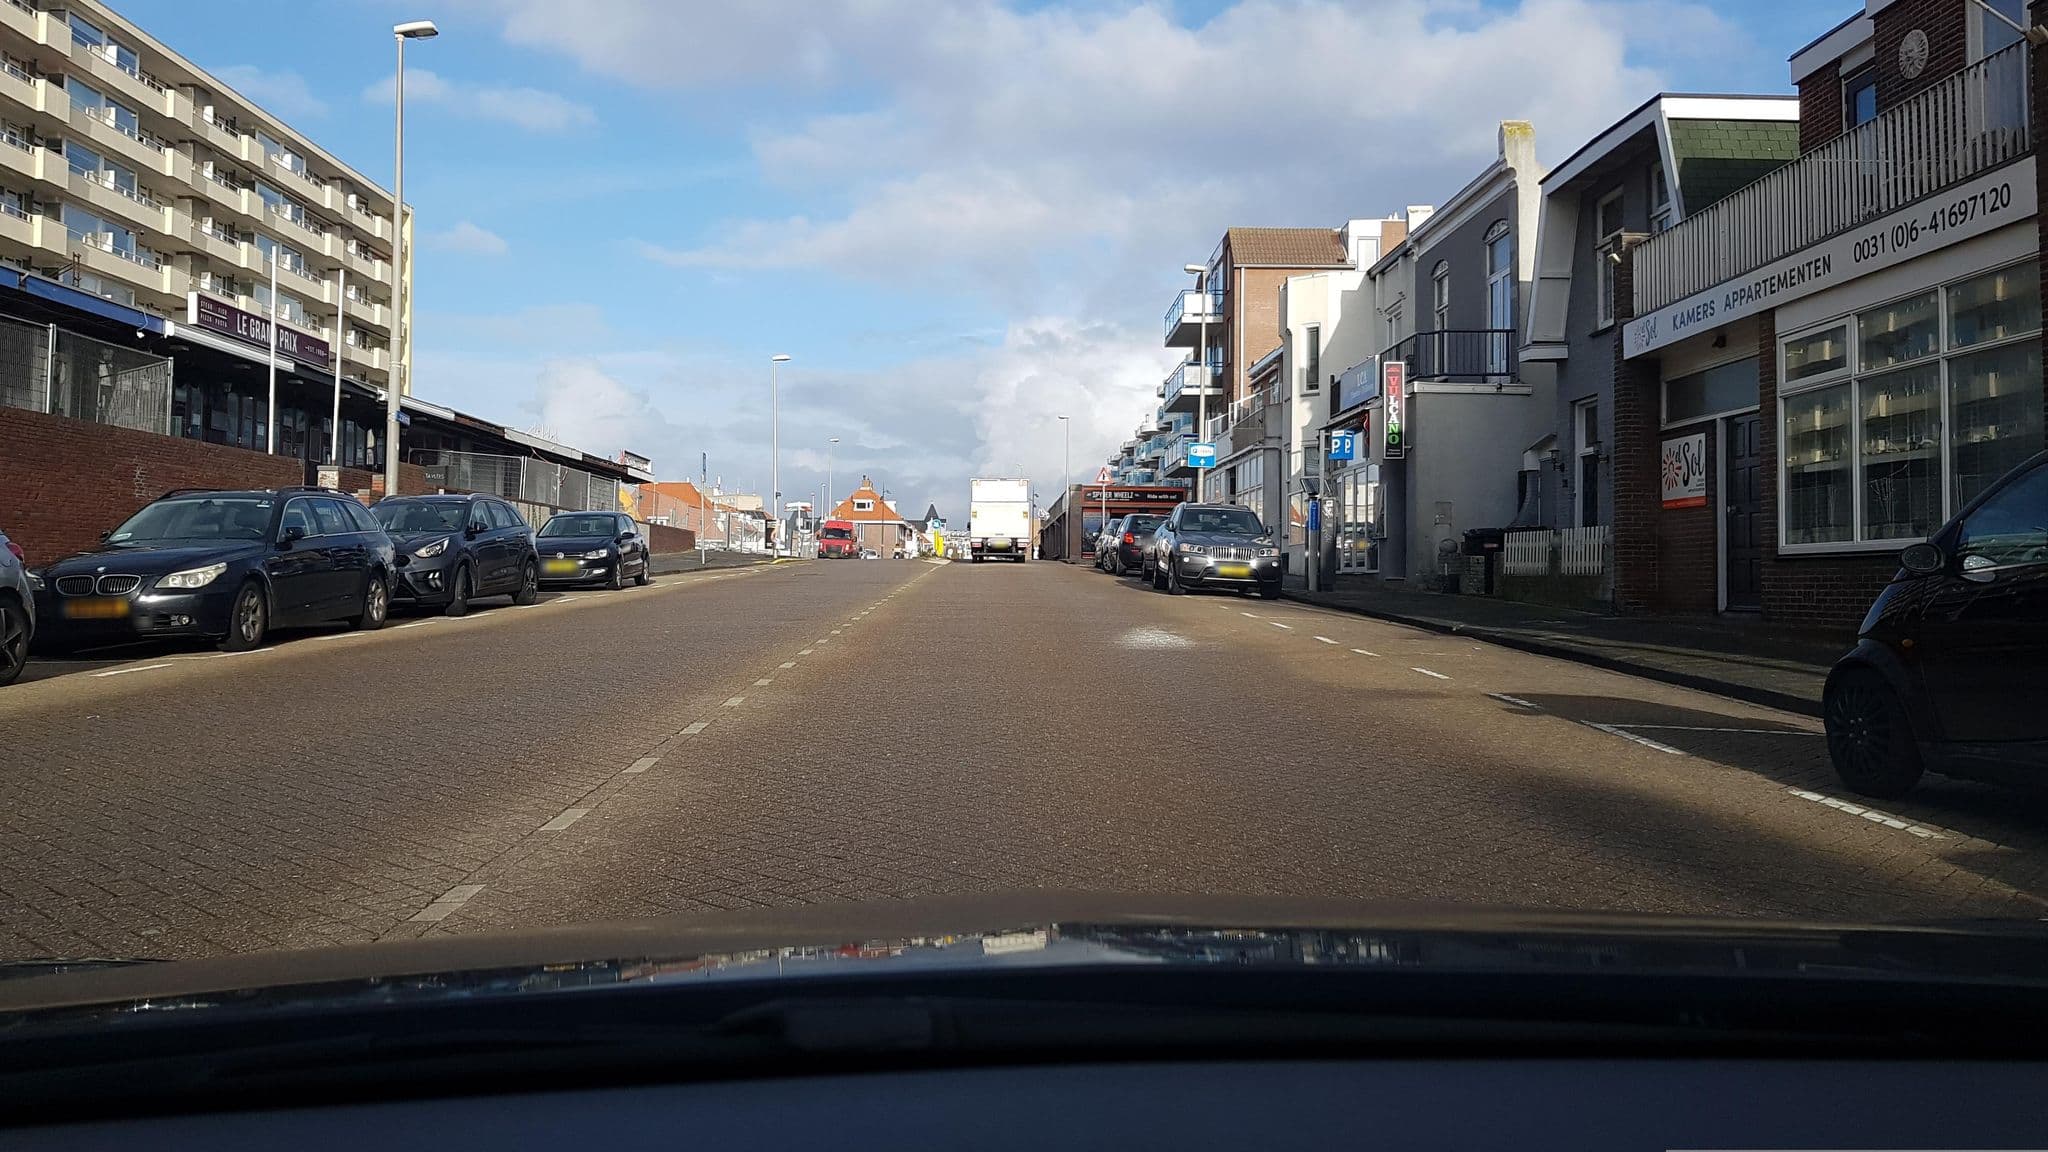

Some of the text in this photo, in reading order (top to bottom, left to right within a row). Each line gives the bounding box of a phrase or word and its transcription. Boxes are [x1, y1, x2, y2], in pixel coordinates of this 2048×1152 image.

[1853, 183, 2011, 263] 0031 (0)6-41697120
[1672, 254, 1831, 331] KAMERS APPARTEMENTEN
[237, 313, 247, 335] LE
[280, 328, 298, 354] PRIX
[1387, 376, 1400, 444] VULCANO
[1683, 439, 1705, 488] Sol
